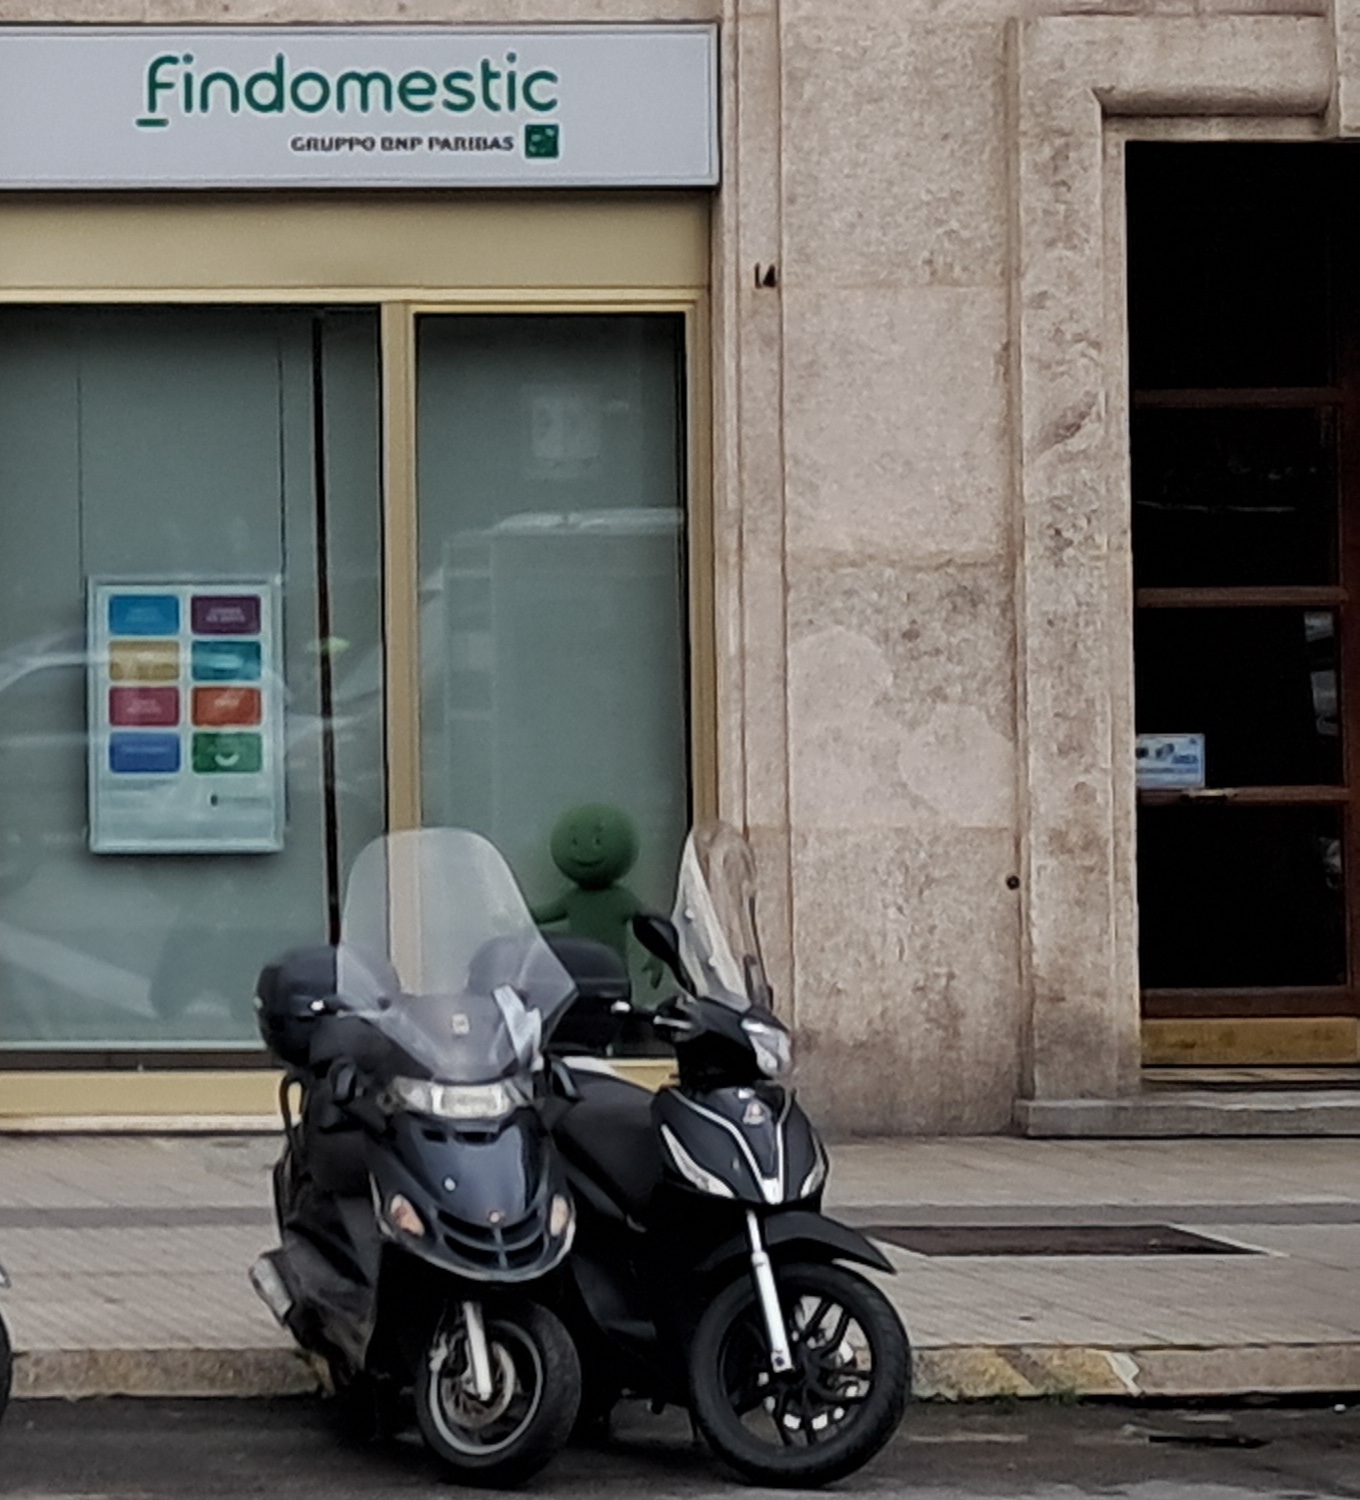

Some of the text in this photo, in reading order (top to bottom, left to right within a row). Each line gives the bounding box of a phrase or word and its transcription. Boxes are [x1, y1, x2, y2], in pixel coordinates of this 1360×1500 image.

[290, 135, 515, 152] GRUPPO BNP PARIBAS
[754, 262, 776, 289] 14
